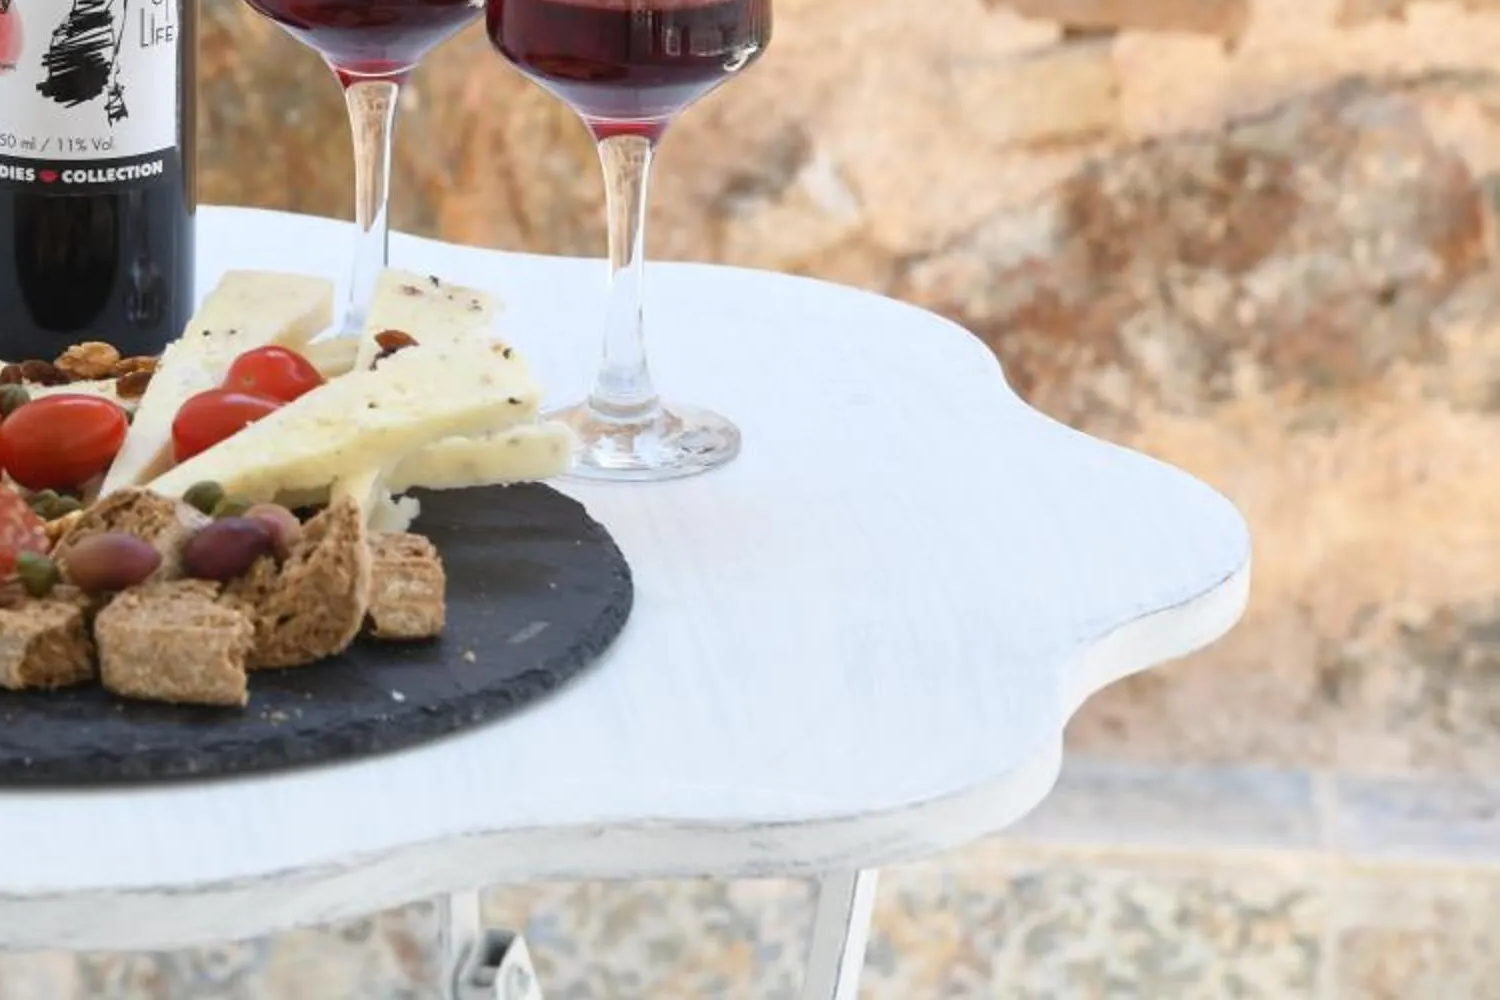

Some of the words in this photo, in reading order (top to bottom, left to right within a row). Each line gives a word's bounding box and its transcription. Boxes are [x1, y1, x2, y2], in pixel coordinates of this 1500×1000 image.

[140, 7, 173, 48] LIFE
[20, 136, 37, 150] ml
[40, 138, 50, 152] /
[57, 137, 87, 152] 11%
[61, 159, 164, 183] COLLECTION
